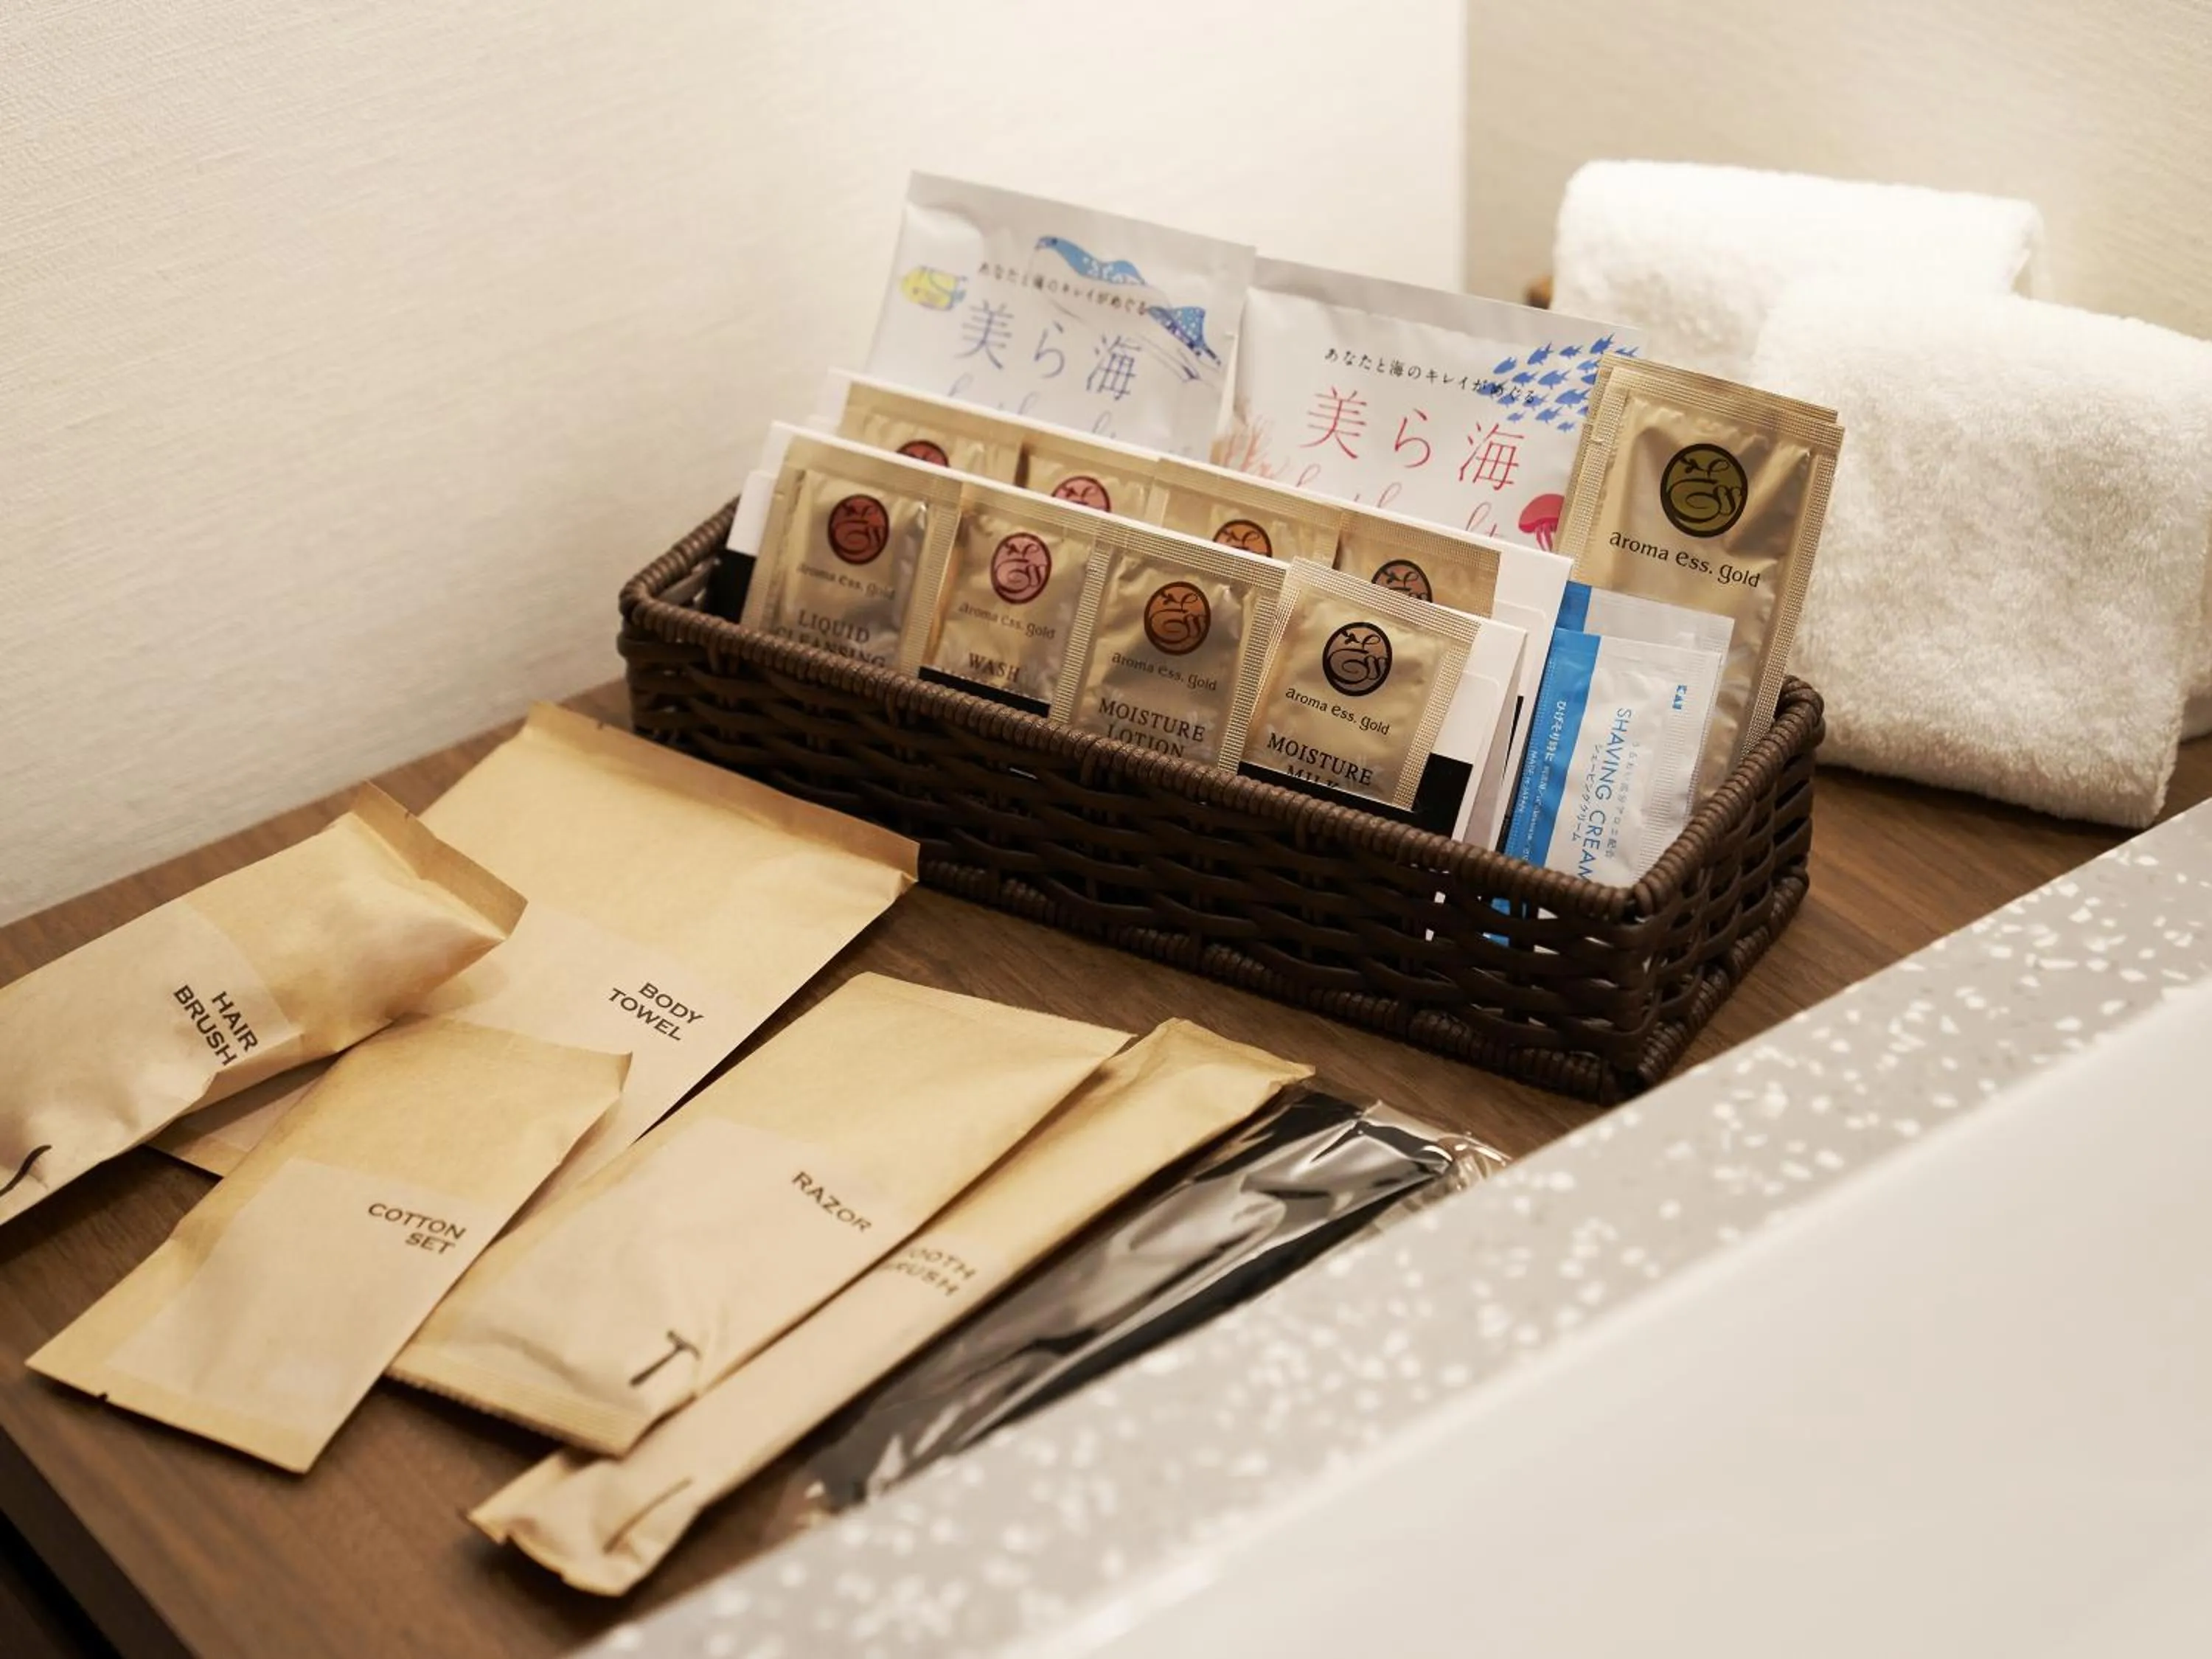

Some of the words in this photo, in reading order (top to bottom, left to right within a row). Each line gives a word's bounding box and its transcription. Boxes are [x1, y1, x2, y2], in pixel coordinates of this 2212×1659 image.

[955, 299, 1142, 400] 美ら海
[1324, 347, 1536, 405] あなたと海のキレイがめぐる
[1300, 386, 1525, 492] 美ら海
[1610, 531, 1669, 561] aroma
[1675, 552, 1714, 574] ess.
[1717, 563, 1761, 588] gold
[798, 608, 870, 644] LIQUID
[959, 602, 999, 624] aroma
[1026, 621, 1056, 640] gold
[968, 653, 1020, 684] WASH
[1111, 651, 1155, 674] aroma
[1158, 662, 1185, 684] ess.
[1187, 671, 1218, 692] gold
[1097, 698, 1207, 743] MOISTURE
[1285, 687, 1328, 712] aroma
[1331, 703, 1357, 725] ess.
[1359, 712, 1391, 737] gold
[1106, 723, 1185, 758] LOTION
[1267, 732, 1374, 787] MOISTURE
[1595, 707, 1632, 801] SHAVING
[173, 984, 238, 1066] BRUSH
[212, 991, 259, 1052] HAIR
[608, 987, 681, 1041] TOWEL
[639, 981, 704, 1024] BODY
[368, 1203, 467, 1240] COTTON
[792, 1171, 872, 1232] RAZOR
[405, 1232, 456, 1254] SET
